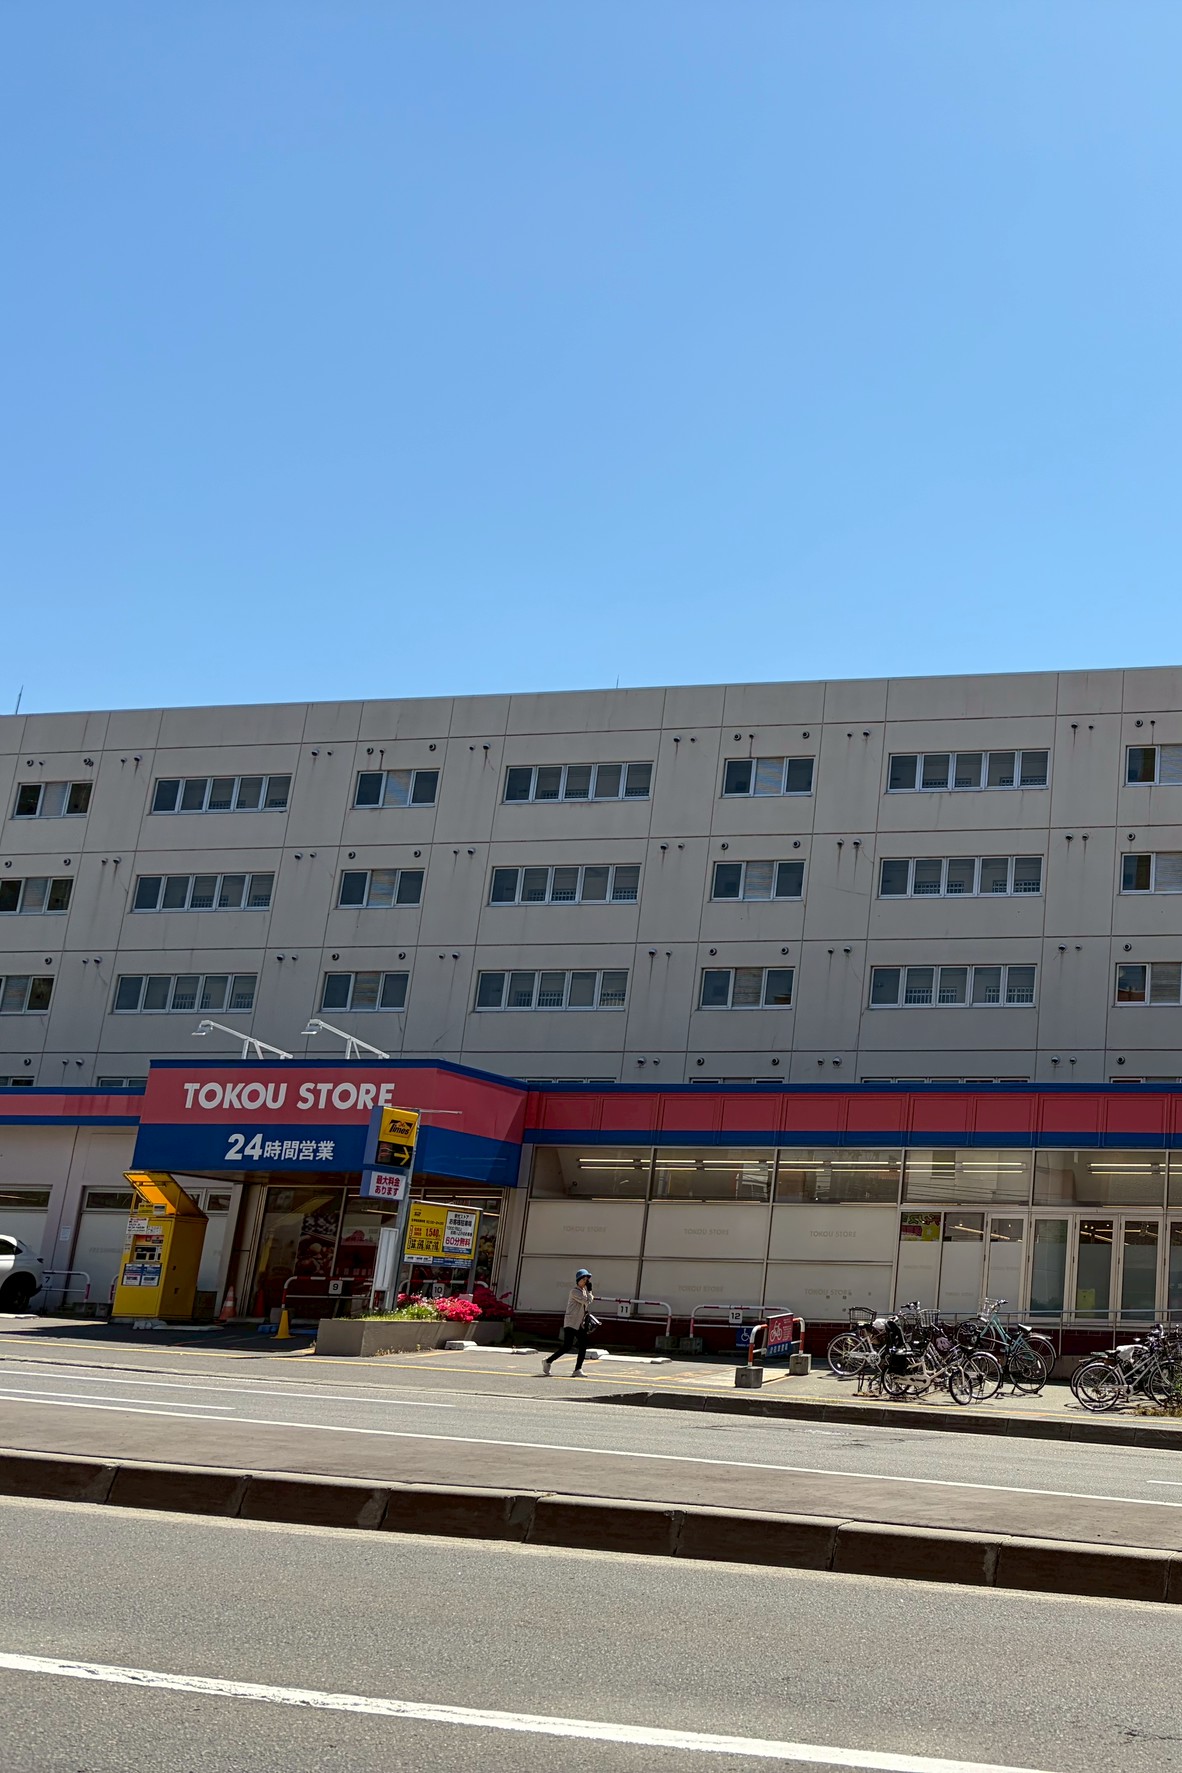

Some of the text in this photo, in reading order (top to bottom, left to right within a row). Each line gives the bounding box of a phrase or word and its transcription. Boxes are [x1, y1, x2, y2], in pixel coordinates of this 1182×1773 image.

[183, 1082, 395, 1110] TOKOU STORE
[389, 1120, 414, 1135] Times
[224, 1133, 336, 1161] 24時間営業
[376, 1175, 401, 1187] 最大料金
[374, 1185, 400, 1197] あります
[332, 1283, 339, 1291] 9
[619, 1305, 629, 1313] 11
[730, 1312, 741, 1320] 12
